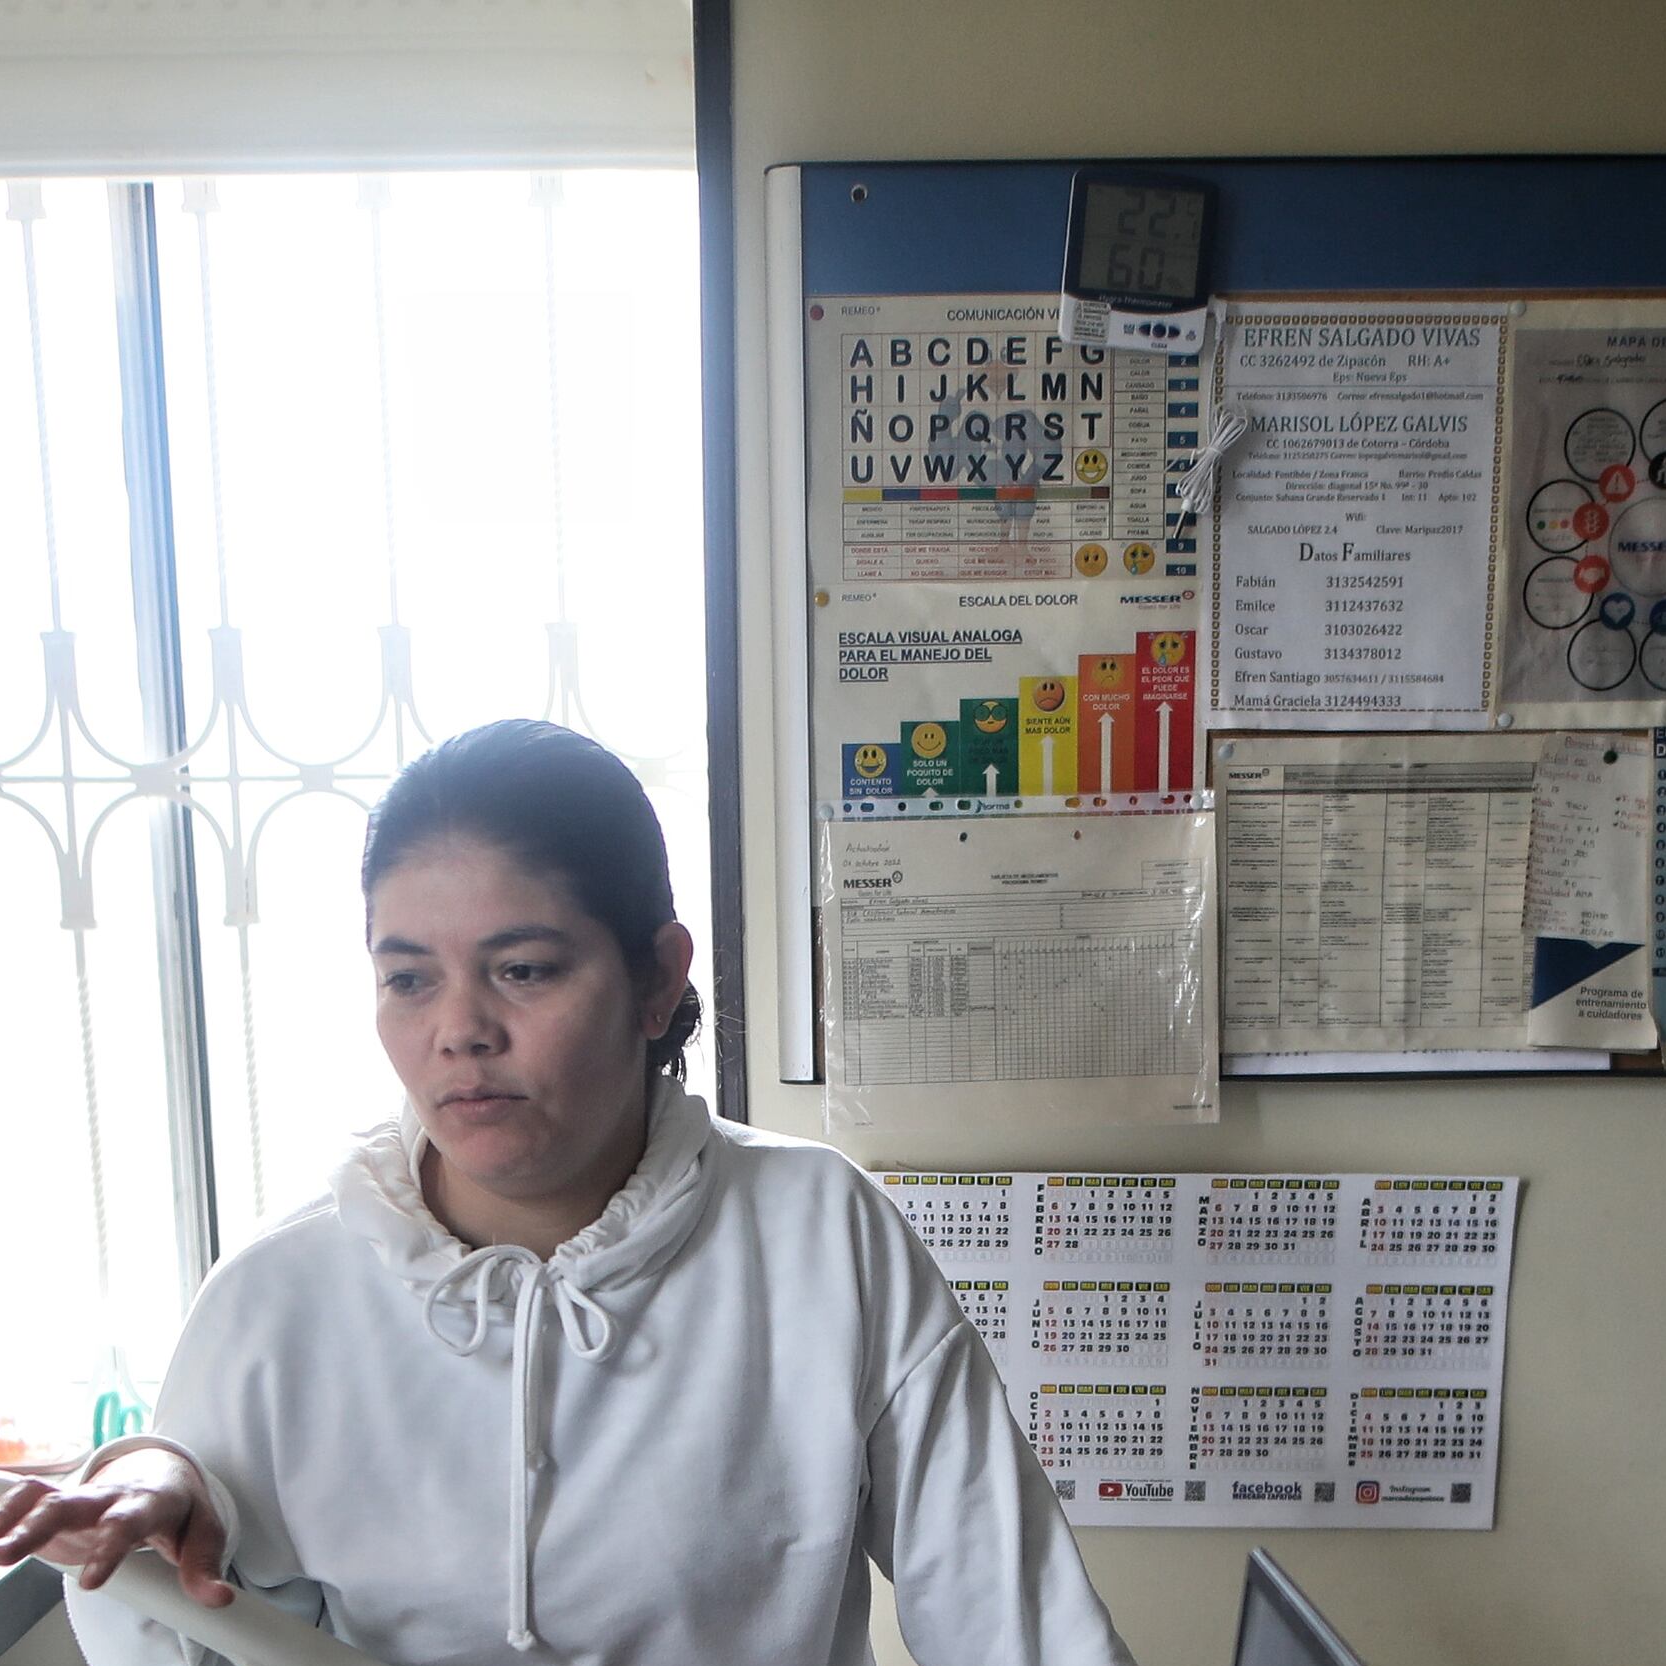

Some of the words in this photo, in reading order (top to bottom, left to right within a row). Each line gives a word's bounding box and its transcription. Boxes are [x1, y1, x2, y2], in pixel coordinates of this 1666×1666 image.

[947, 306, 1045, 322] COMUNICACIÓN
[1244, 328, 1312, 348] EFREN
[1319, 328, 1415, 347] SALGADO
[1423, 328, 1481, 346] VIVAS
[1607, 336, 1647, 348] MAPA
[849, 338, 874, 368] A
[889, 338, 912, 366] B
[927, 338, 951, 366] C
[967, 338, 989, 366] D
[1005, 336, 1027, 366] E
[1046, 336, 1063, 364] F
[1080, 346, 1105, 365] G
[1407, 356, 1430, 368] RH:
[1433, 356, 1451, 368] A+
[851, 374, 873, 404] H
[897, 374, 905, 404] I
[929, 374, 947, 402] J
[967, 373, 989, 402] K
[1007, 373, 1026, 400] L
[1041, 372, 1067, 400] M
[1081, 372, 1103, 400] N
[1179, 380, 1187, 390] 3
[1179, 406, 1187, 416] 4
[851, 408, 873, 444] Ñ
[889, 414, 913, 442] O
[929, 414, 949, 442] P
[965, 414, 991, 444] Q
[1005, 414, 1027, 441] R
[1043, 412, 1065, 441] S
[1081, 412, 1103, 440] T
[1251, 416, 1334, 433] MARISOL
[1339, 412, 1398, 432] LÓPEZ
[1403, 416, 1467, 432] GALVIS
[1179, 435, 1186, 446] 5
[851, 456, 873, 483] U
[890, 455, 911, 483] V
[923, 454, 955, 482] W
[967, 454, 987, 482] X
[1005, 454, 1025, 482] Y
[1042, 454, 1064, 480] Z
[1299, 542, 1338, 562] Datos
[1341, 542, 1411, 562] Familiares
[1175, 566, 1187, 575] 10
[1235, 576, 1276, 588] Fabián
[959, 594, 1007, 608] ESCALA
[1009, 594, 1033, 608] DEL
[1035, 594, 1078, 606] DOLOR
[1120, 594, 1182, 605] MESSER
[1235, 600, 1275, 612] Emilce
[1235, 624, 1269, 636] Oscar
[839, 632, 895, 644] ESCALA
[897, 630, 950, 644] VISUAL
[953, 630, 1023, 642] ANALOGA
[839, 650, 877, 662] PARA
[880, 649, 899, 662] EL
[901, 648, 961, 662] MANEJO
[964, 647, 992, 660] DEL
[1235, 648, 1283, 660] Gustavo
[839, 668, 889, 680] DOLOR
[1152, 666, 1179, 675] DOLOR
[1235, 671, 1266, 684] Efren
[1269, 671, 1321, 686] Santiago
[1152, 684, 1178, 692] PUEDE
[1083, 694, 1100, 702] CON
[1101, 693, 1130, 702] MUCHO
[1235, 695, 1271, 707] Mamá
[1273, 694, 1321, 707] Graciela
[1092, 702, 1120, 711] DOLOR
[1025, 717, 1052, 726] SIENTE
[1025, 726, 1042, 735] MAS
[1043, 726, 1071, 735] DOLOR
[912, 759, 933, 768] SOLO
[934, 759, 947, 768] UN
[906, 769, 940, 778] POQUITO
[941, 768, 954, 777] DE
[850, 778, 892, 787] CONTENTO
[916, 778, 944, 786] DOLOR
[849, 787, 866, 796] SIN
[867, 786, 893, 795] DOLOR
[842, 878, 892, 889] MESSER
[1580, 986, 1627, 998] Programa
[1630, 989, 1644, 999] de
[1575, 998, 1647, 1010] entrenamiento
[1586, 1009, 1643, 1020] cuidadores
[1034, 1184, 1045, 1256] FEBRERO
[1197, 1196, 1209, 1247] MARZO
[1359, 1198, 1371, 1248] ABRIL
[1031, 1299, 1041, 1350] JUNIO
[1193, 1300, 1202, 1351] JULIO
[1124, 1482, 1175, 1498] YouTube
[1233, 1480, 1301, 1494] facebook
